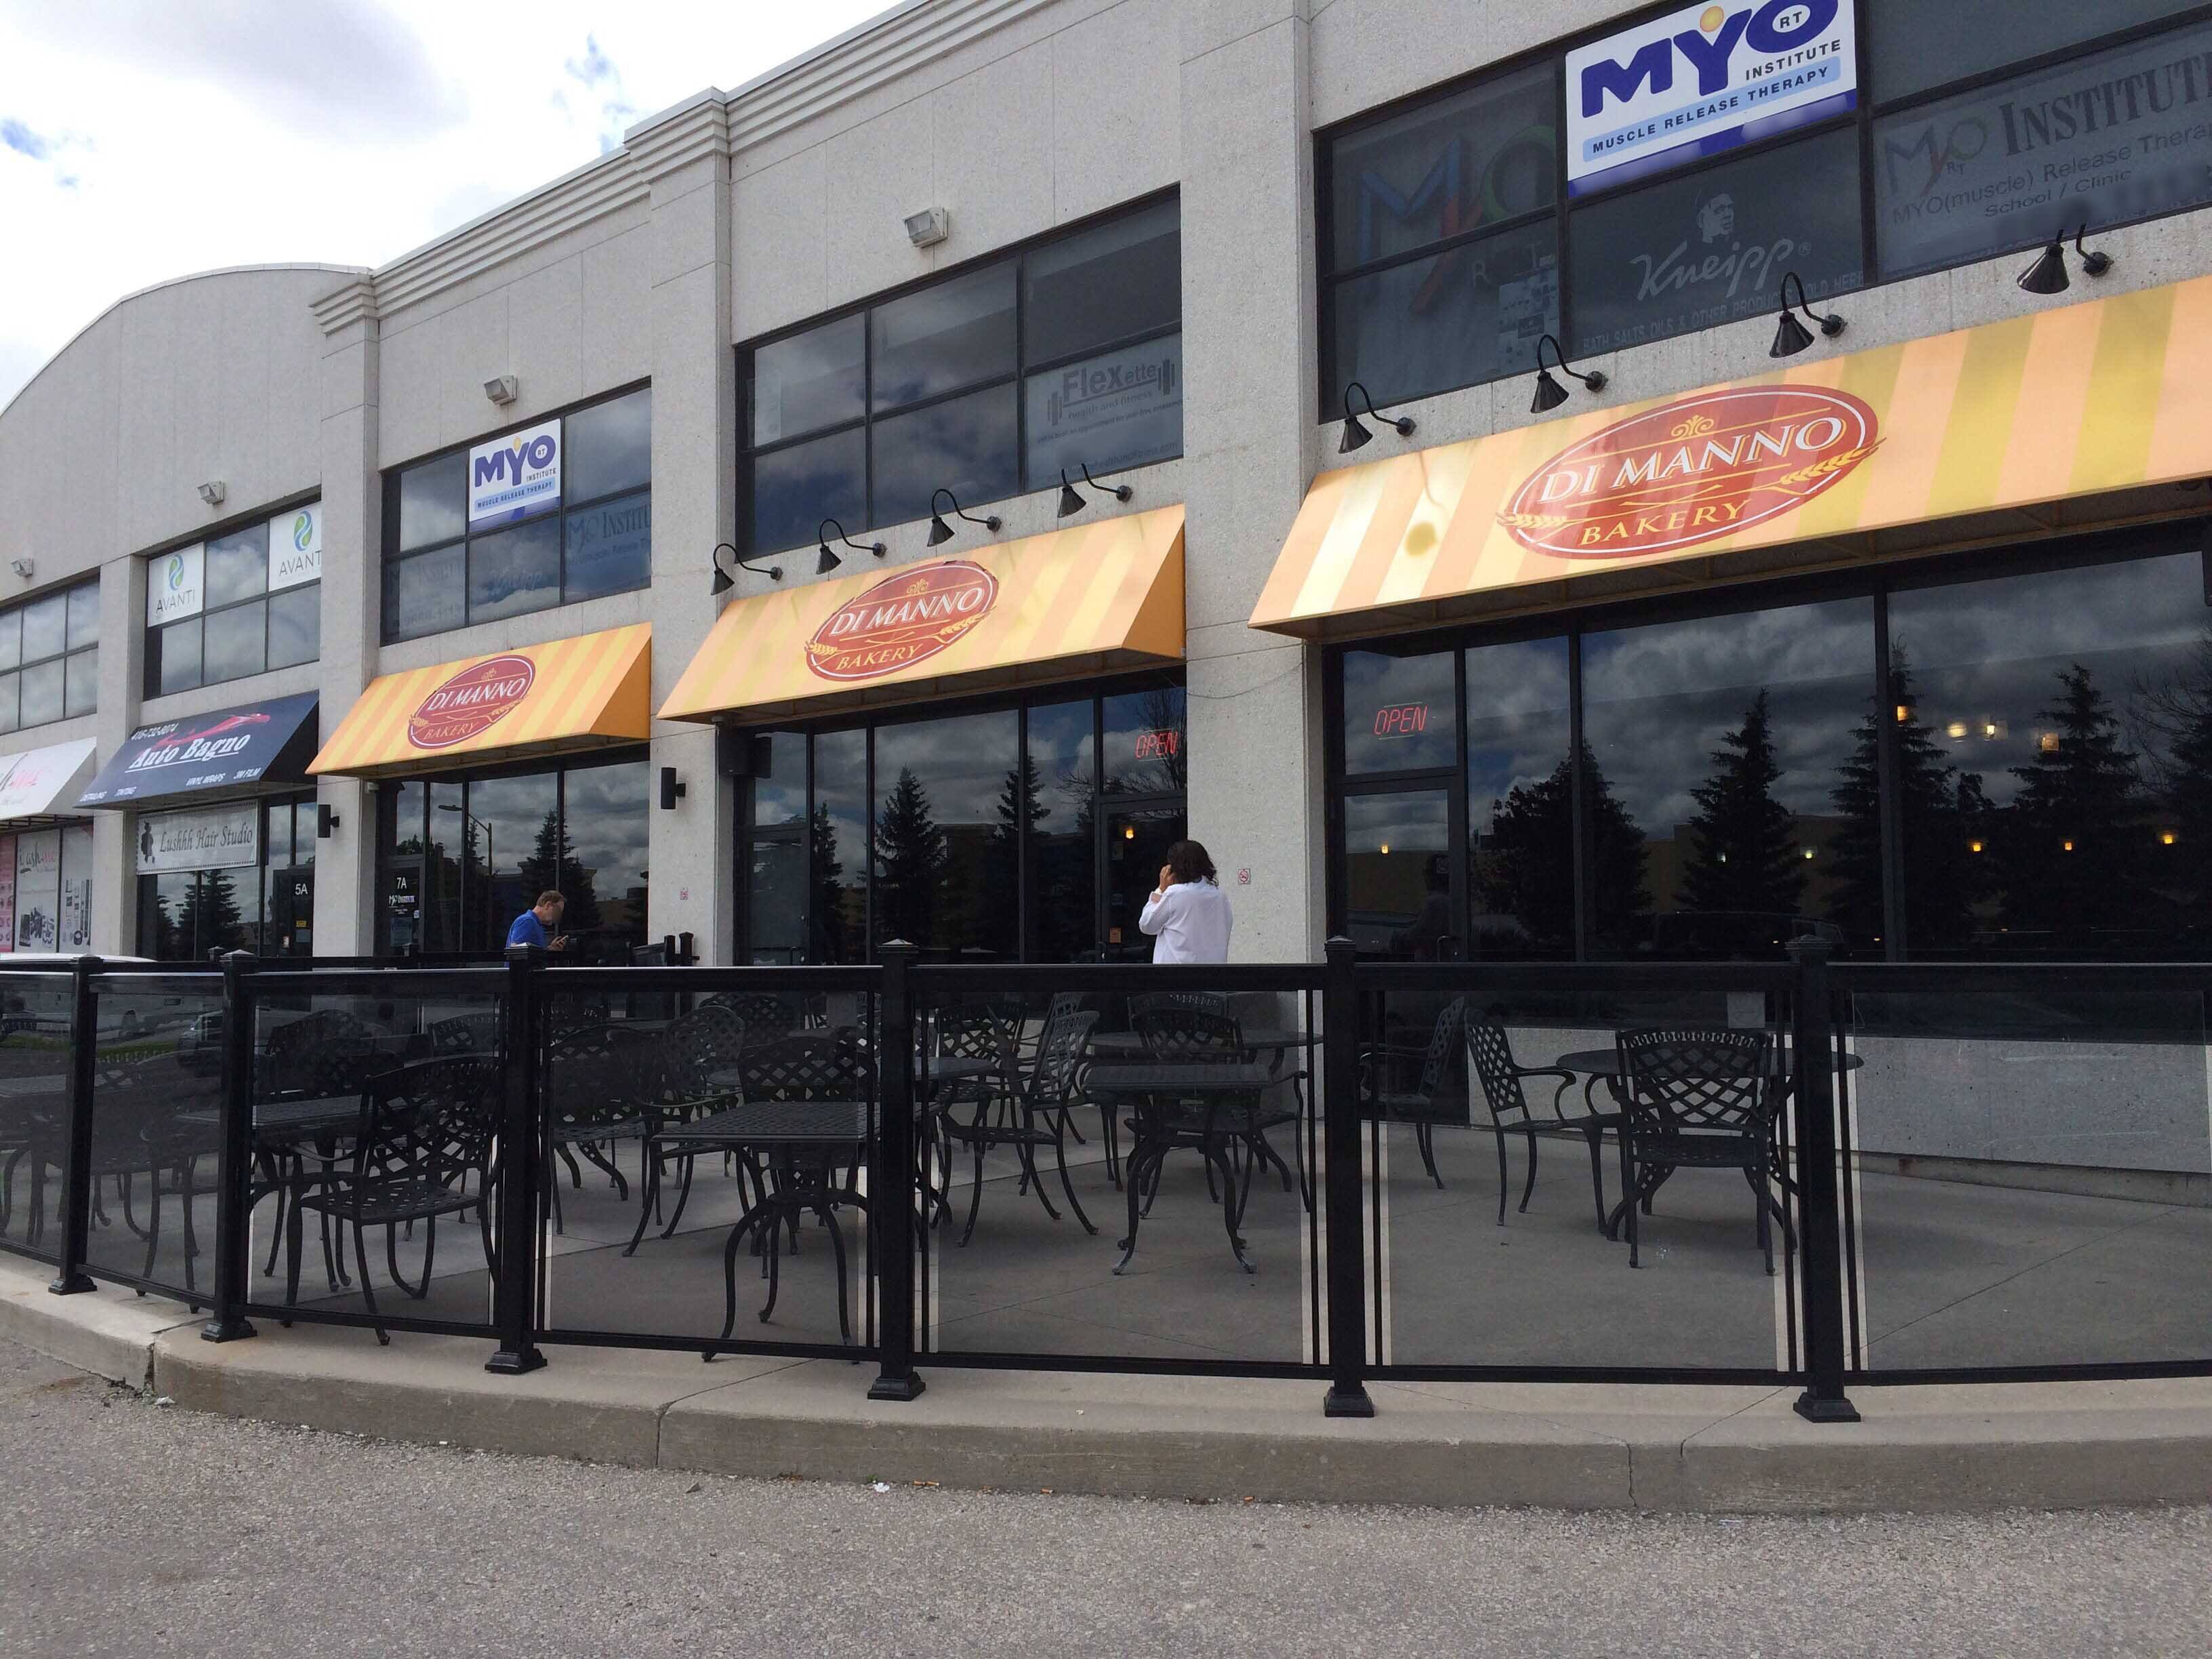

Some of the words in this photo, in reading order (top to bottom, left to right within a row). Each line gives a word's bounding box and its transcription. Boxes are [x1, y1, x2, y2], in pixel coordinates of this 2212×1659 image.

[1779, 12, 1803, 28] RT
[1581, 0, 1839, 118] MYO
[1746, 39, 1841, 81] INSTITUTE
[1593, 124, 1656, 153] MUSCLE
[1664, 96, 1740, 129] RELEASE
[1748, 66, 1828, 101] THERAPY
[2044, 146, 2131, 182] Release
[2137, 123, 2212, 153] Thera
[1985, 190, 2052, 218] School
[2074, 169, 2132, 193] Clinic
[1629, 238, 1795, 301] Kneipp
[474, 435, 556, 487] MYO
[526, 468, 556, 483] INSTITUTE
[1536, 465, 1603, 502] DI
[1612, 417, 1847, 489] MANNO
[477, 497, 499, 508] MUSCLE
[501, 490, 525, 502] RELEASE
[527, 481, 552, 495] THERAPY
[602, 504, 651, 539] INSTITU
[1580, 499, 1752, 546] BAKERY
[279, 550, 322, 577] AVANT
[156, 588, 195, 614] AVANTI
[830, 610, 865, 636] DI
[867, 587, 985, 628] MANNO
[835, 644, 923, 670] BAKERY
[428, 691, 453, 710] DI
[451, 678, 526, 707] MANNO
[424, 721, 478, 740] BAKERY
[1372, 705, 1428, 736] OPEN
[128, 743, 180, 769] Auto
[182, 734, 251, 762] Bagno
[1135, 731, 1179, 760] OPEN
[195, 827, 219, 850] Hair
[220, 822, 253, 848] Studio
[295, 883, 308, 896] 5A
[396, 877, 407, 890] 7A
